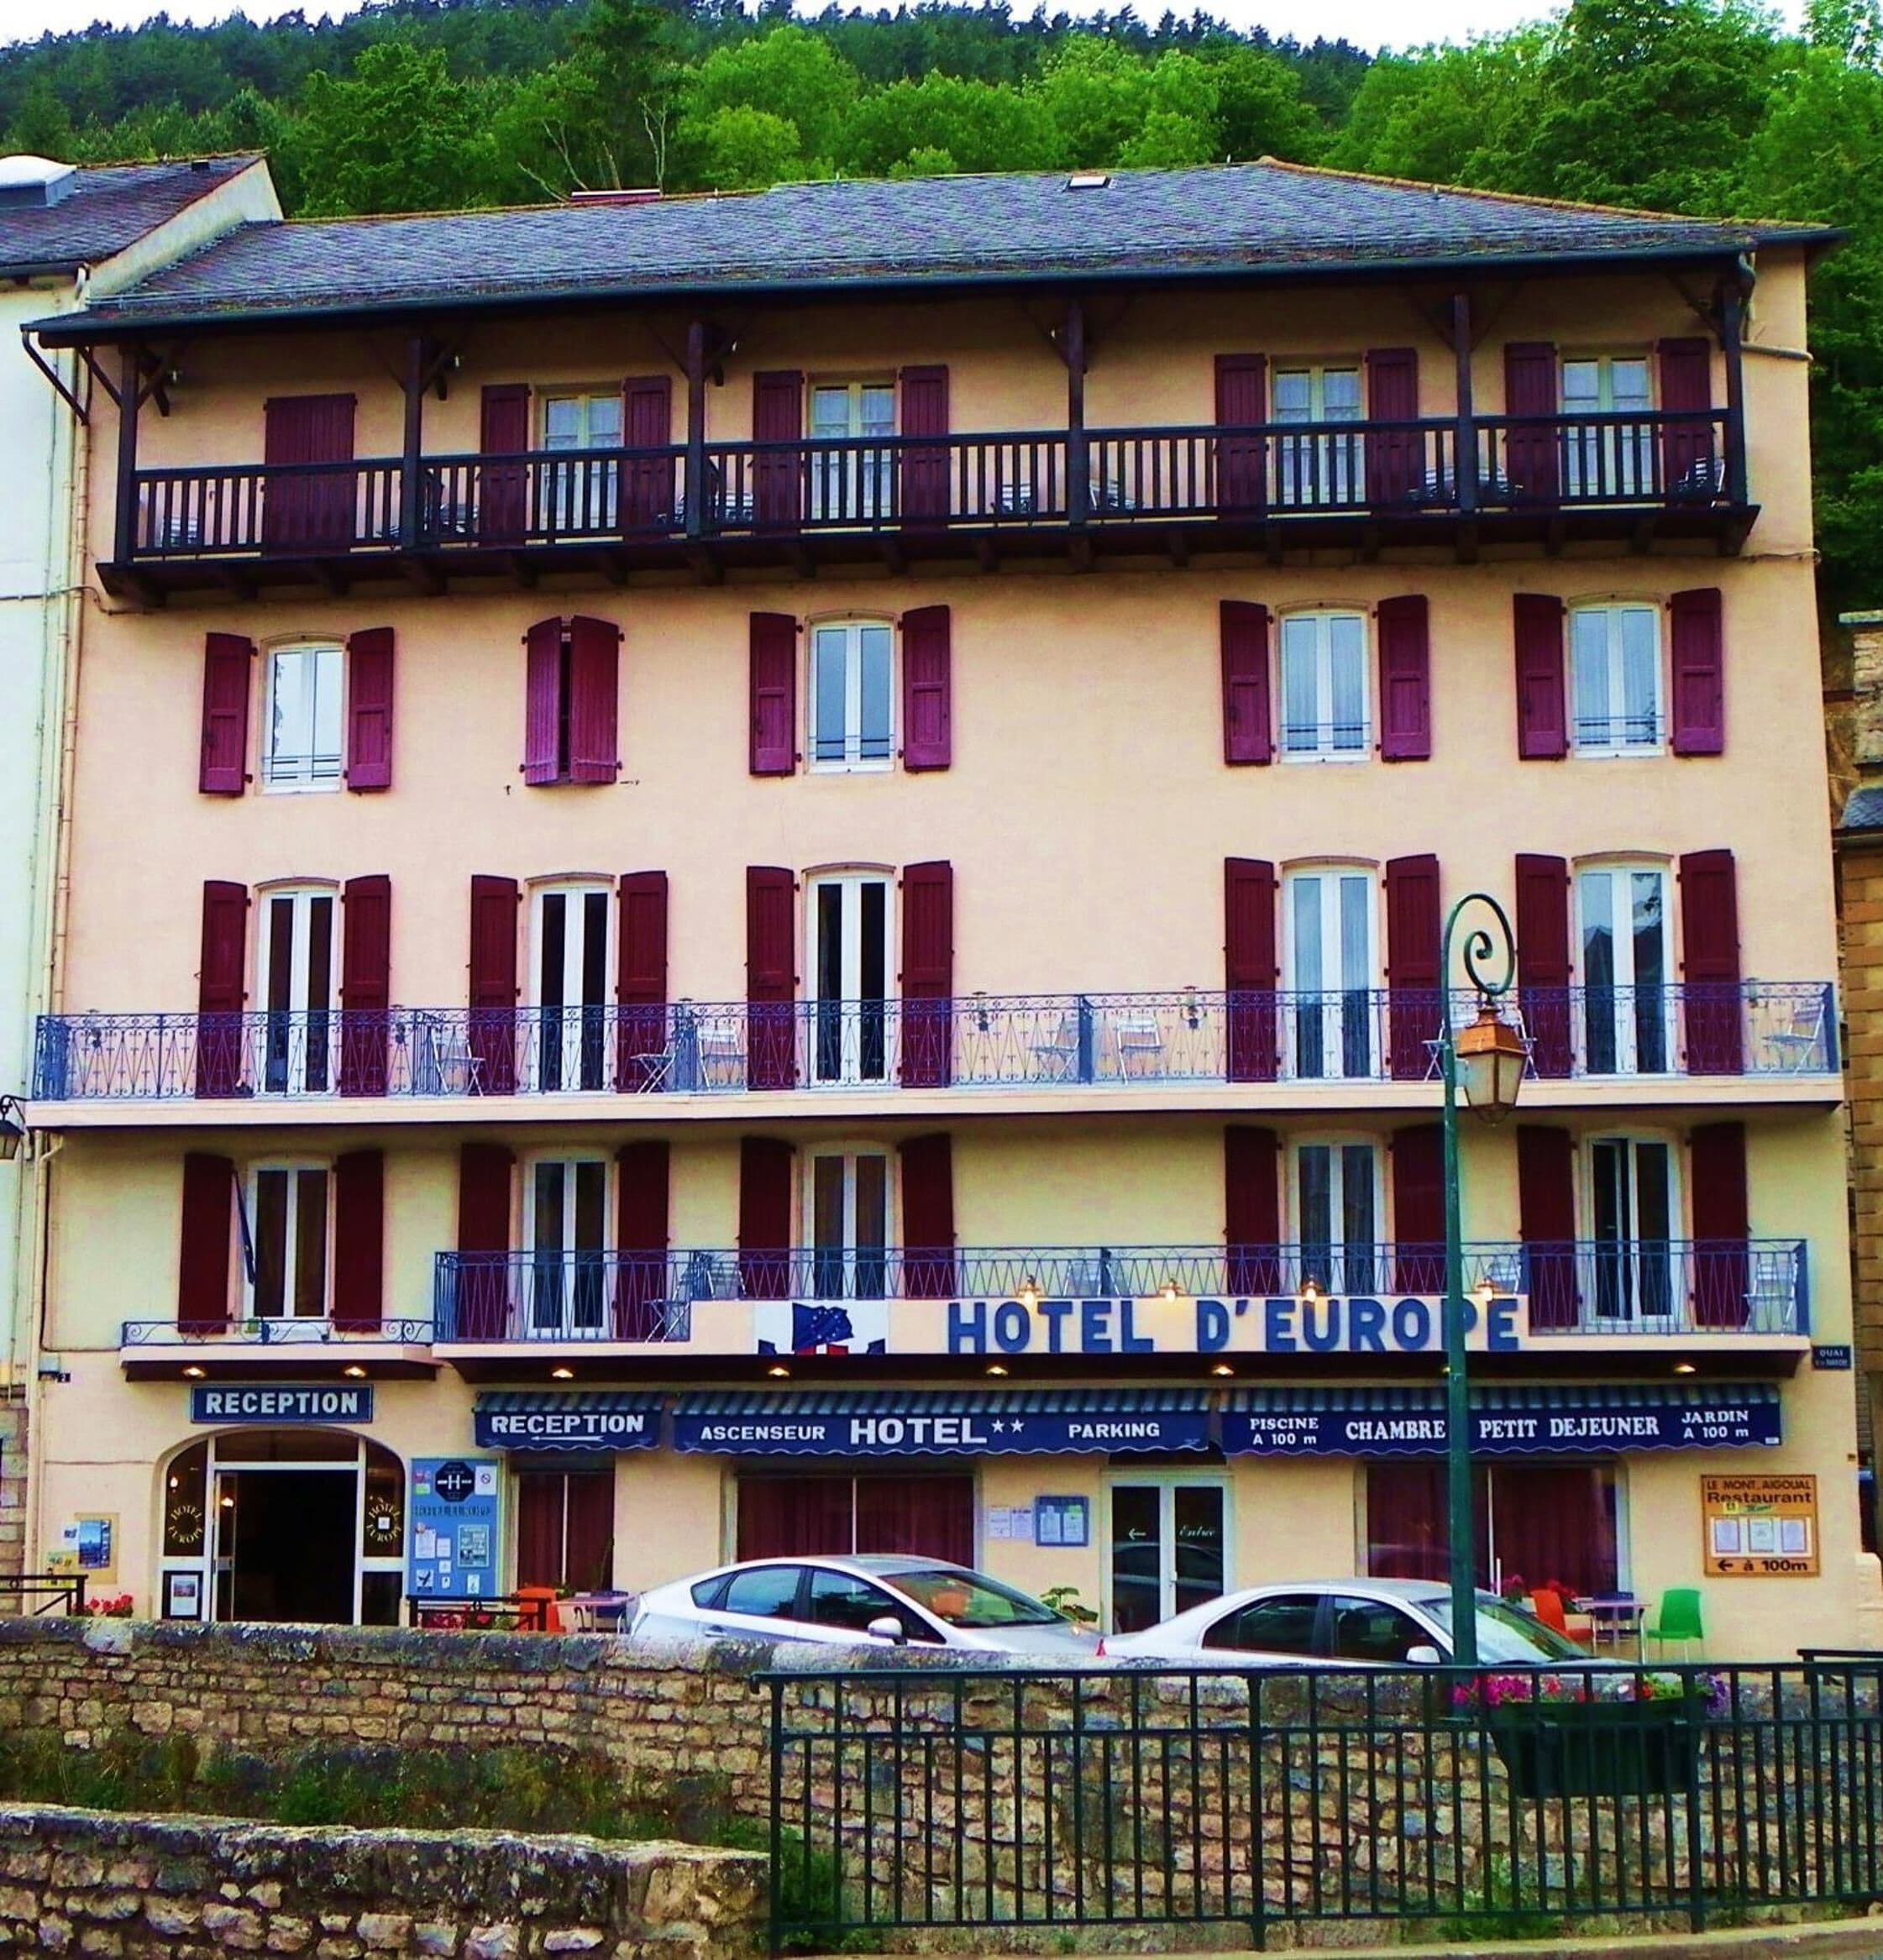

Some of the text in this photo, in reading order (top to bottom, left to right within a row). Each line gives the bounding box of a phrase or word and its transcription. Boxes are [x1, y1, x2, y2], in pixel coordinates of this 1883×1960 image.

[948, 1298, 1519, 1354] HOTEL D'EUROPE
[1819, 1349, 1844, 1358] QUAI
[206, 1392, 358, 1414] RECEPTION
[1681, 1410, 1749, 1423] JARDIN
[491, 1414, 644, 1433] RECEPTION
[1250, 1418, 1319, 1430] PISCINE
[1345, 1417, 1660, 1440] CHAMBRE PETIT DEJEUNER
[700, 1418, 1160, 1444] ASCENSEUR HOTEL PARKING
[1683, 1427, 1749, 1439] A 100 m
[1253, 1433, 1317, 1445] A 100 m
[1707, 1480, 1717, 1490] LE
[1762, 1480, 1811, 1490] AIGOUAL
[1707, 1491, 1812, 1503] Restaurant
[1743, 1559, 1808, 1572] à 100m
